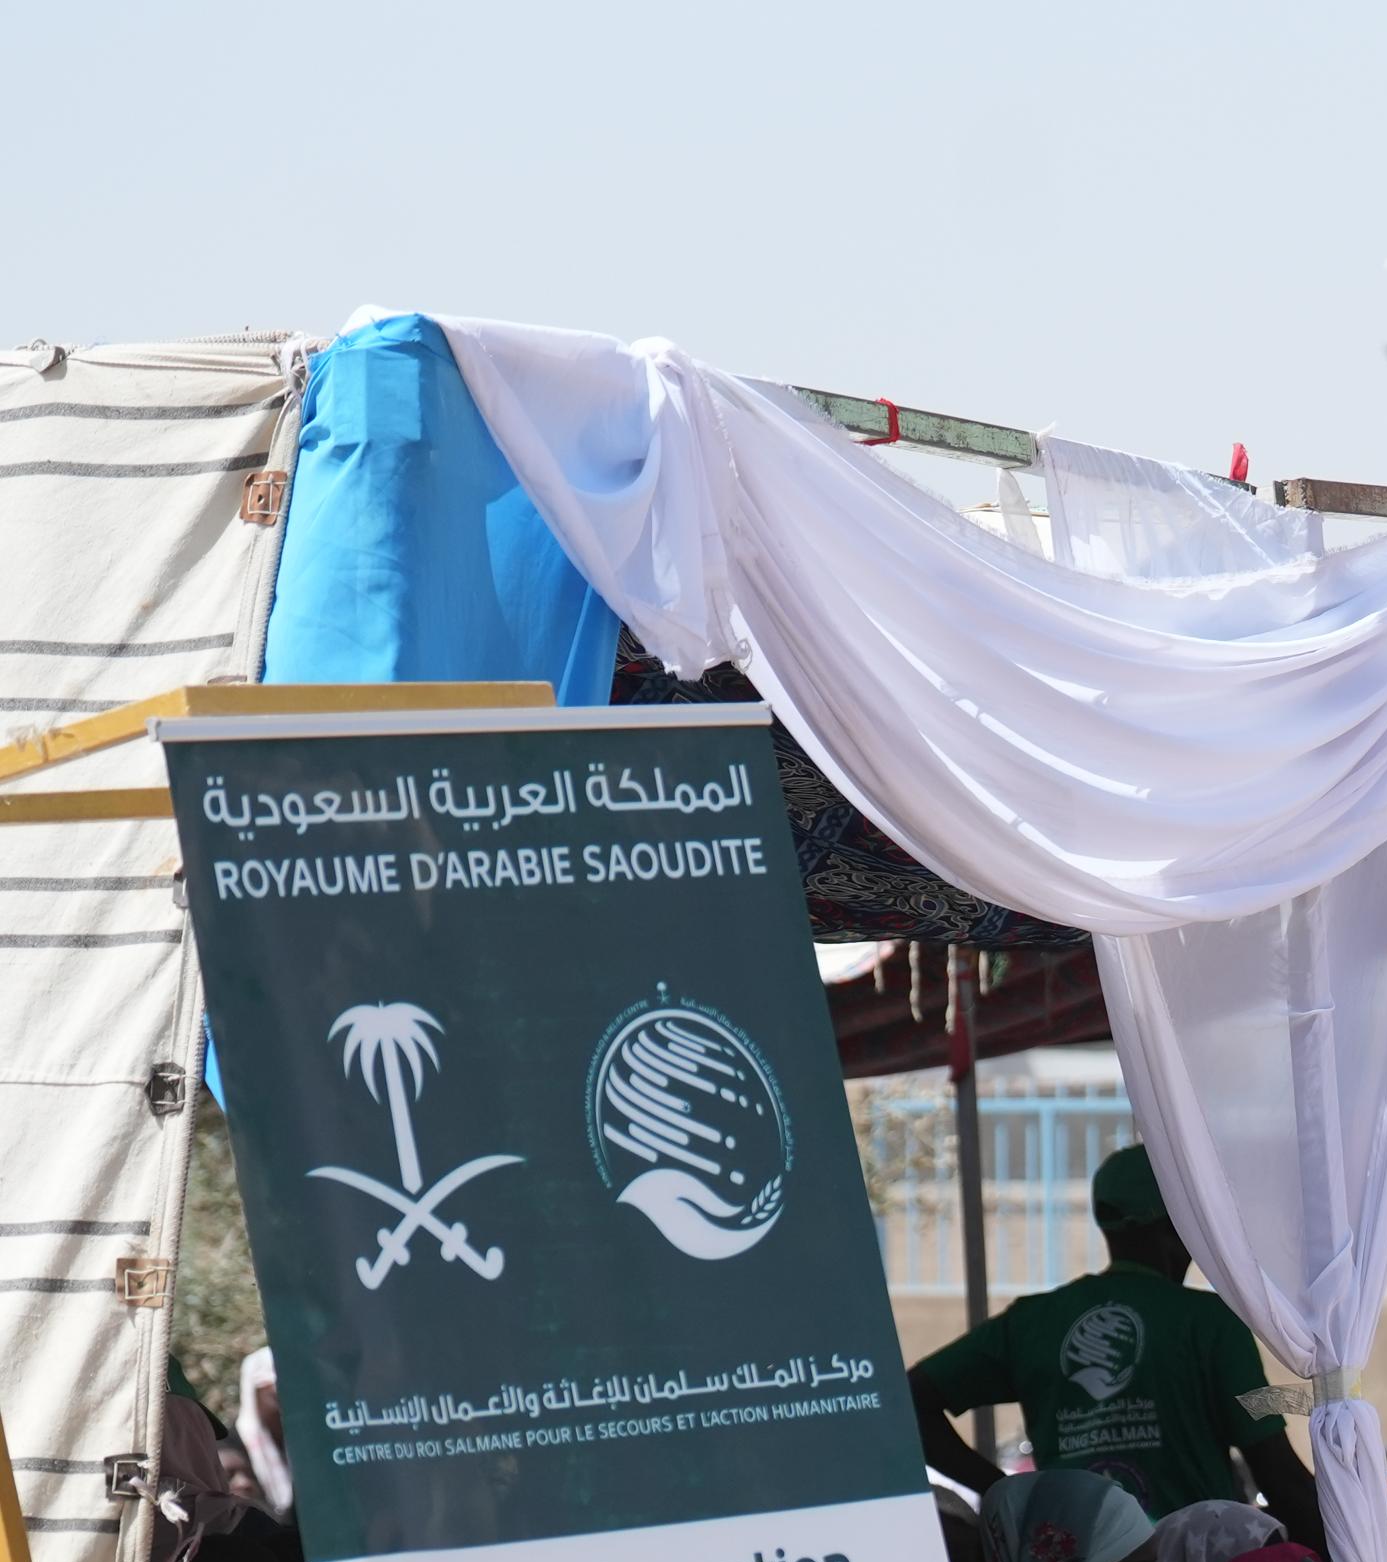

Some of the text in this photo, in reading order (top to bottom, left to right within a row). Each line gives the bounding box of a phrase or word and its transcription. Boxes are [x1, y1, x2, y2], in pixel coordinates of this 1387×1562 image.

[203, 763, 752, 841] المملكة العربية السعودية
[214, 838, 766, 900] ROYAUME D'ARABIE SAOUDITE
[325, 1353, 874, 1434] مركز الملك سلمان للإغاثة والأعمال الإنسانية
[333, 1393, 881, 1465] CENTRE DU ROI SALMANE POUR LE SECOURS ET L'ACTION HUMANITAIRE
[1059, 1436, 1088, 1451] KING
[1089, 1424, 1161, 1444] SALMAN
